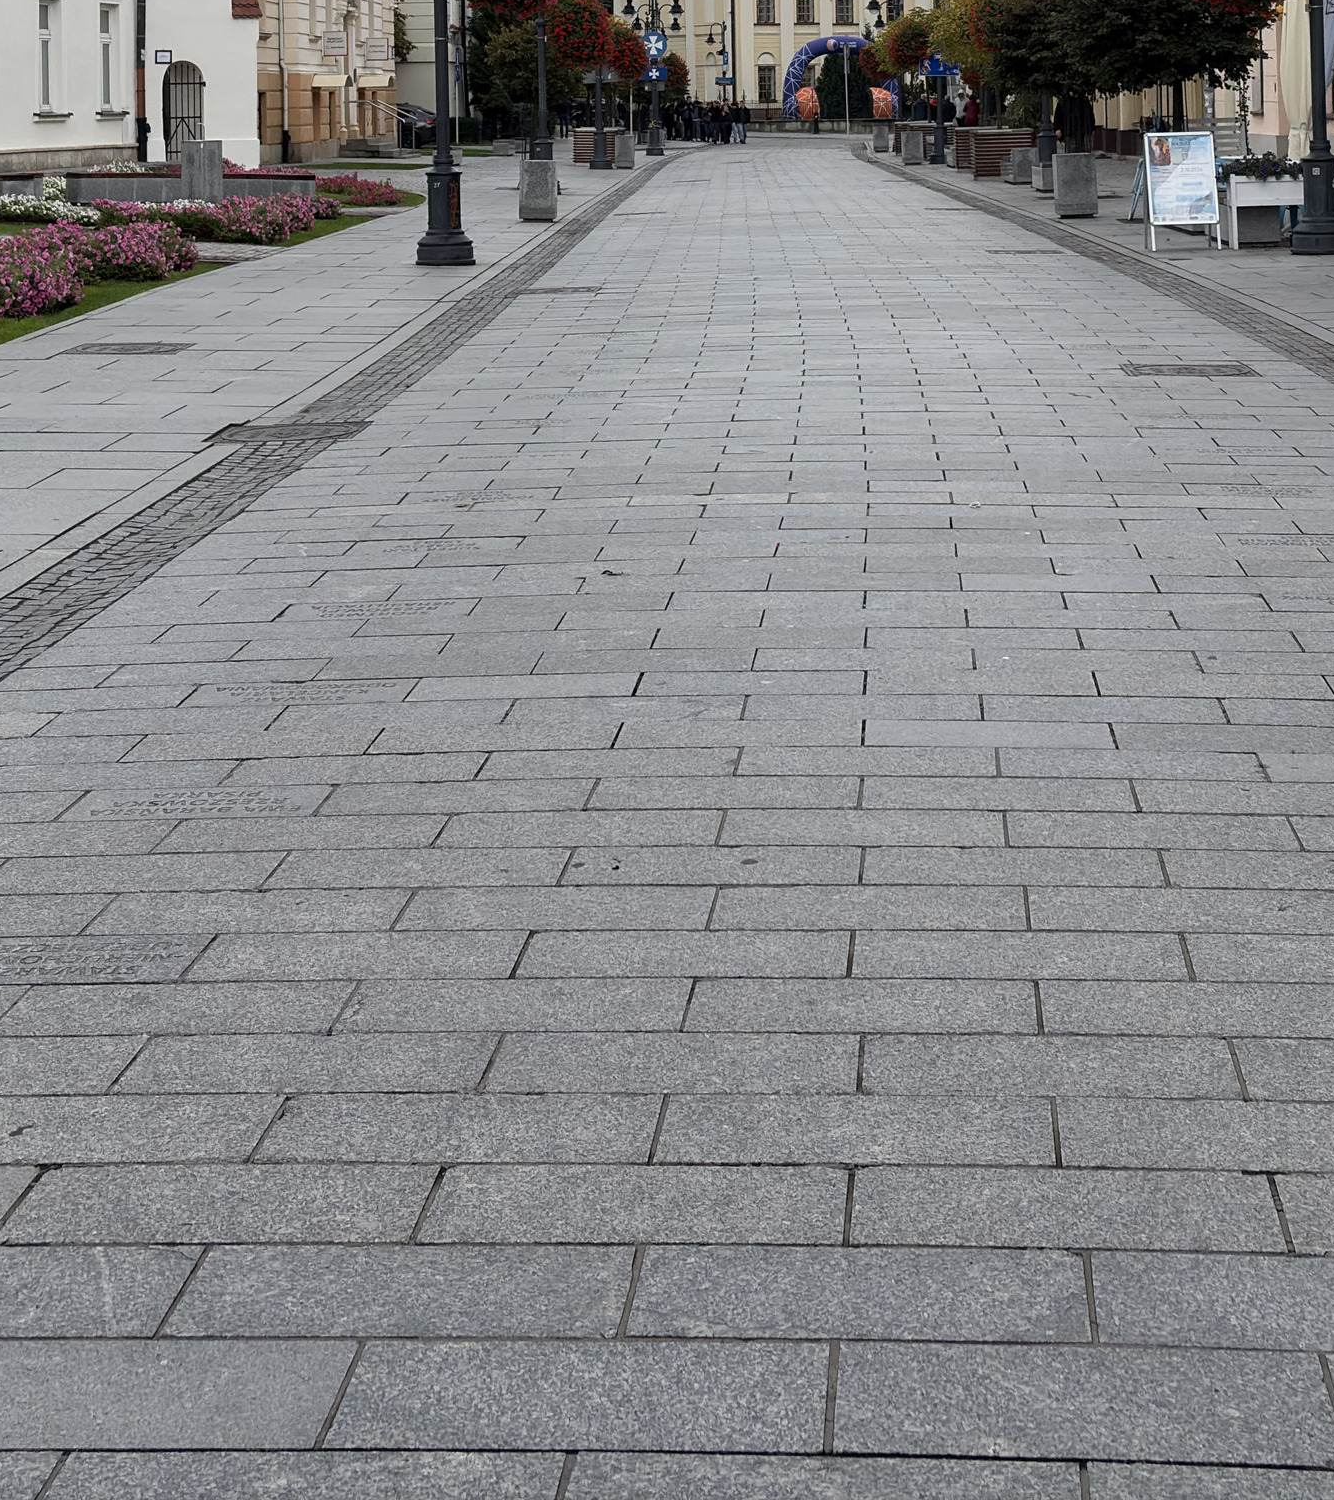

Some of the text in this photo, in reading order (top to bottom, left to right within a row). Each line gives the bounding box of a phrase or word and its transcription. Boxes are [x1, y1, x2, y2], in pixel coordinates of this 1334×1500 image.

[230, 689, 368, 697] KANCELARIA
[113, 798, 288, 807] RZESZOWSKA
[90, 807, 234, 817] BARAŃSKA
